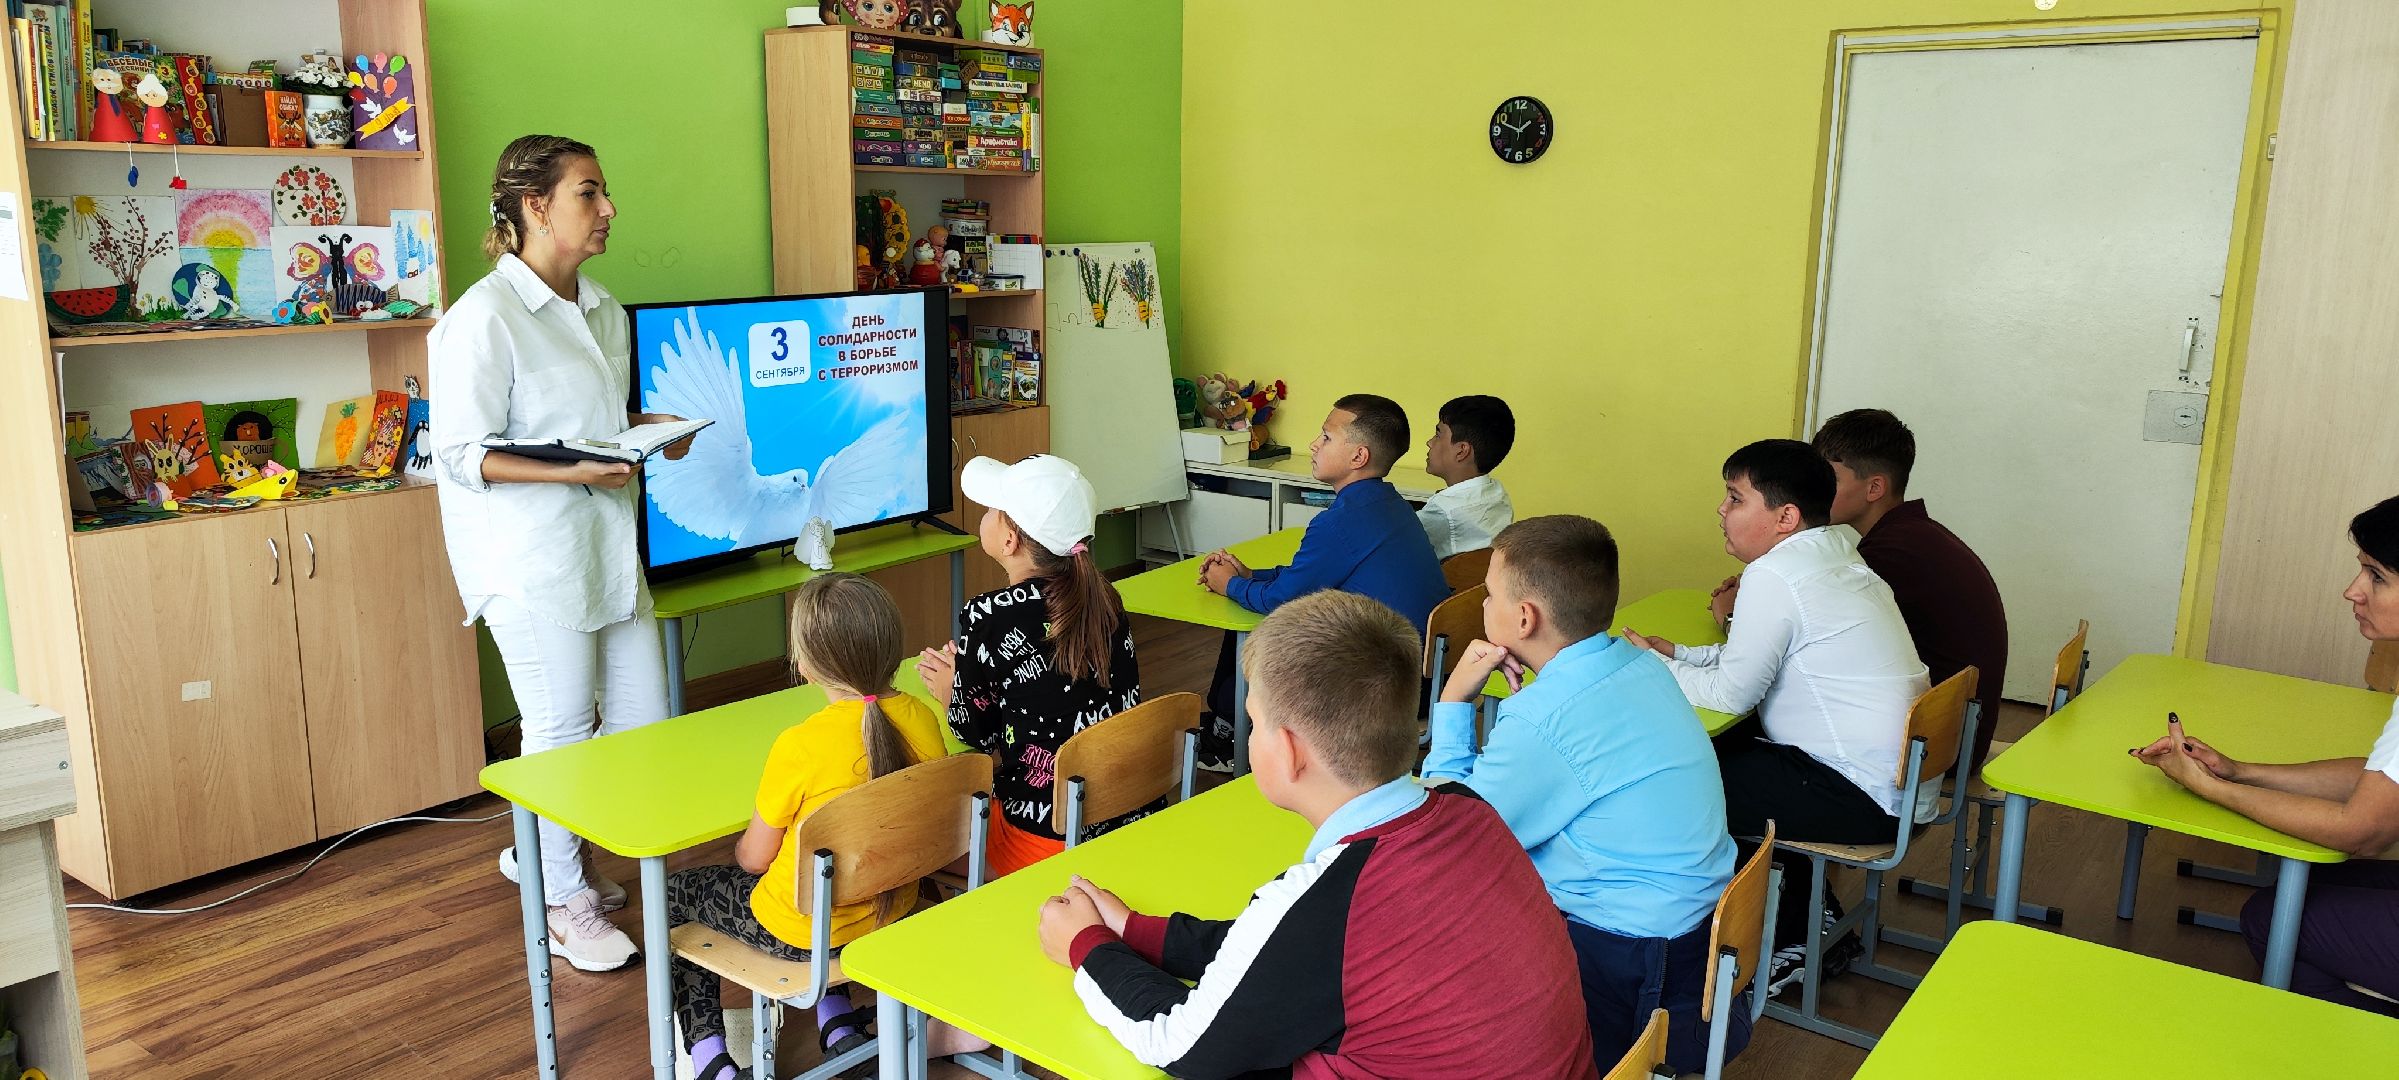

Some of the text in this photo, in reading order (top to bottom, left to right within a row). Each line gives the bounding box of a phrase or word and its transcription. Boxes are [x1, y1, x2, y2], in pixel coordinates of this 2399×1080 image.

[105, 54, 154, 67] ВЕСЁЛЫЕ
[160, 66, 170, 77] 3
[1503, 102, 1513, 112] 11
[1514, 99, 1528, 110] 12
[1496, 112, 1508, 124] 10
[1492, 125, 1502, 137] 9
[1539, 123, 1546, 135] 3
[1503, 147, 1512, 159] 7
[1514, 150, 1523, 162] 6
[1525, 147, 1534, 158] 5
[851, 314, 885, 329] ДЕНЬ
[818, 328, 917, 347] СОЛИДАРНОСТИ
[770, 326, 789, 362] 3
[838, 346, 897, 362] В БОРЬБЕ
[755, 366, 805, 380] СЕНТЯБРЯ
[818, 359, 919, 381] С ТЕРРОРИЗМОМ
[968, 583, 1042, 624] TODAY
[997, 626, 1027, 661] DREAM
